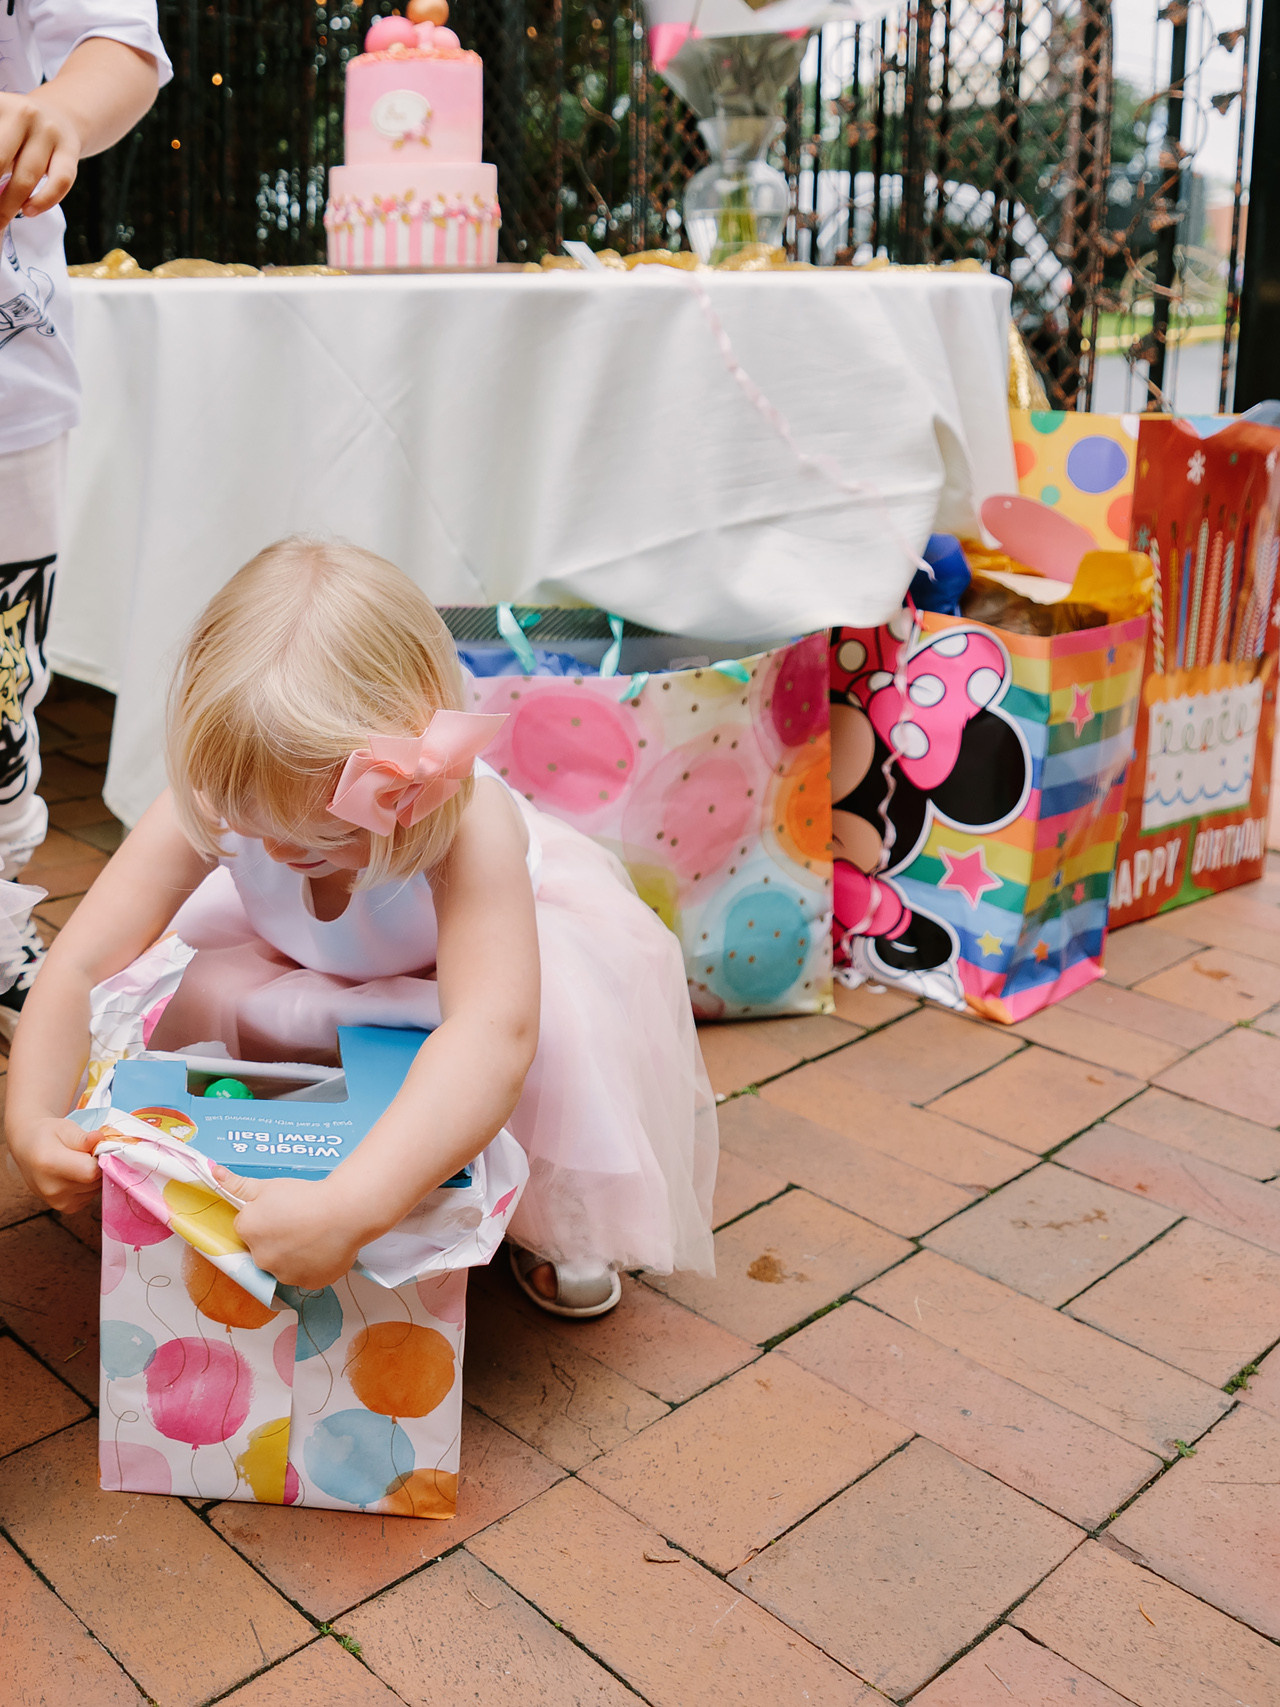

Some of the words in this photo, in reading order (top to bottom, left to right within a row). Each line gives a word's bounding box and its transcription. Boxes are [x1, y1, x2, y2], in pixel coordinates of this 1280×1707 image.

[278, 1134, 343, 1145] Crawl
[232, 1142, 249, 1153] &
[255, 1143, 340, 1157] Wiggle
